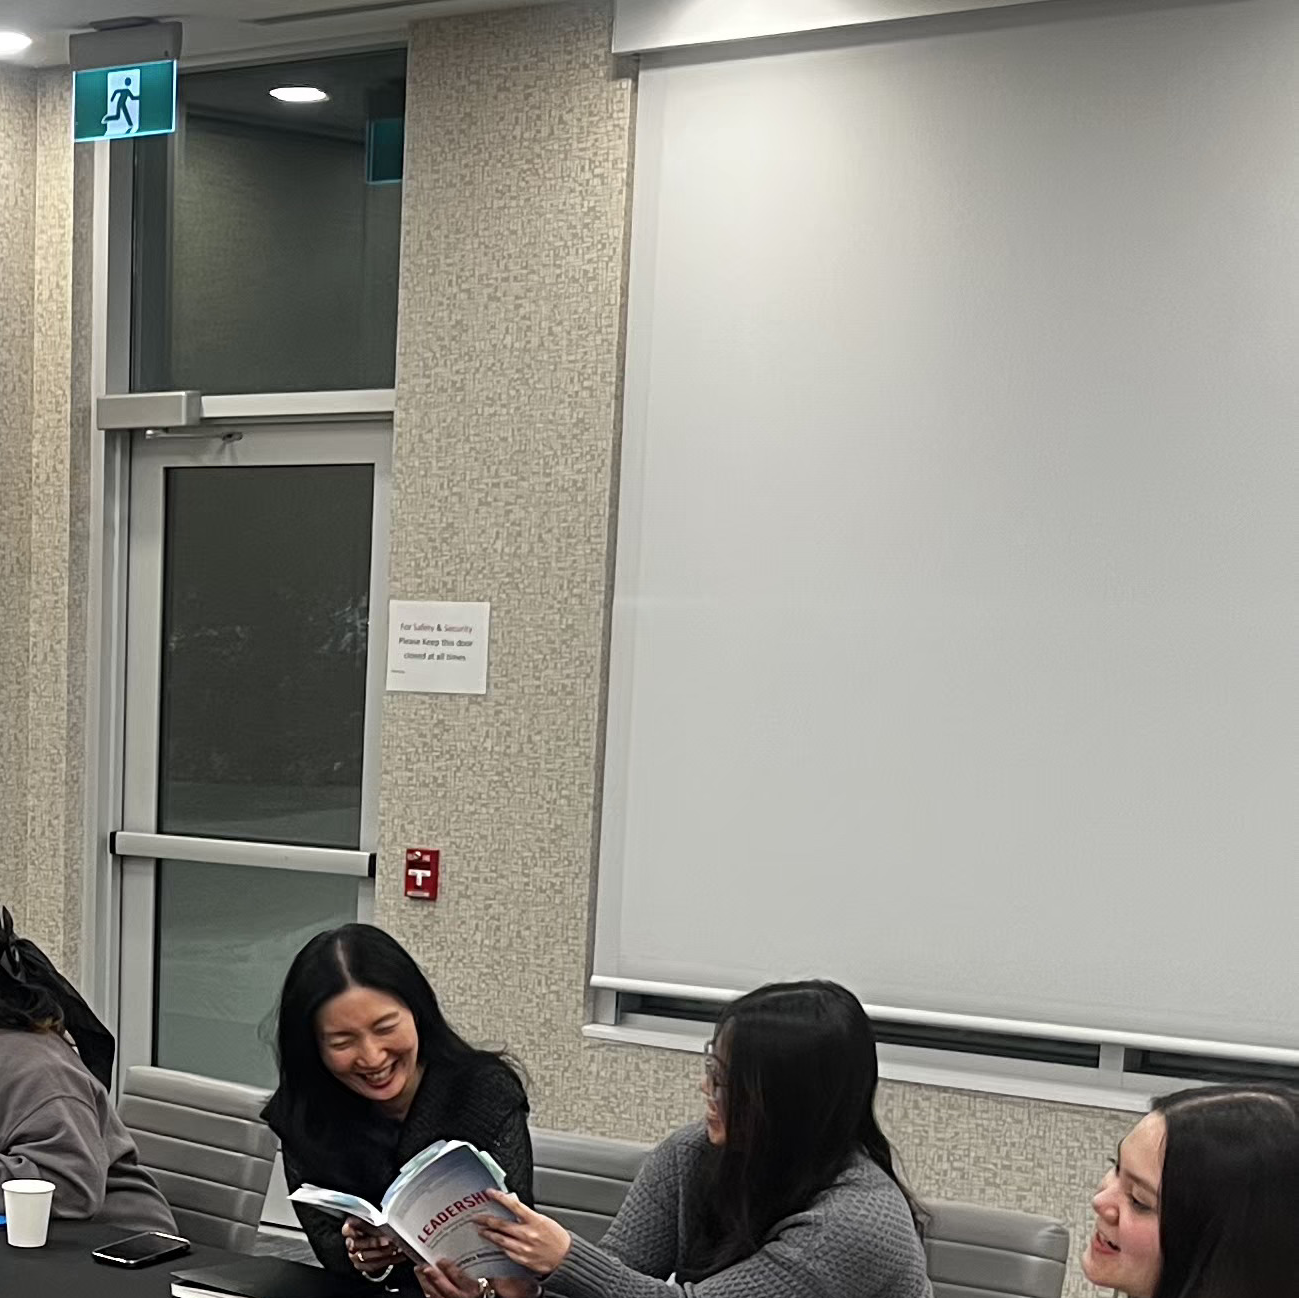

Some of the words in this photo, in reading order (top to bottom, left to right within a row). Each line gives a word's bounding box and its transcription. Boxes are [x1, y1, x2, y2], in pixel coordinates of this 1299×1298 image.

[400, 623, 412, 631] For
[413, 623, 435, 632] Safety
[444, 624, 473, 634] Security
[398, 637, 421, 645] Please
[441, 639, 455, 647] this
[456, 639, 473, 647] door
[403, 652, 427, 660] closed
[427, 653, 435, 661] at
[436, 653, 445, 661] all
[446, 653, 466, 662] times
[417, 1189, 492, 1244] LEADERSHI
